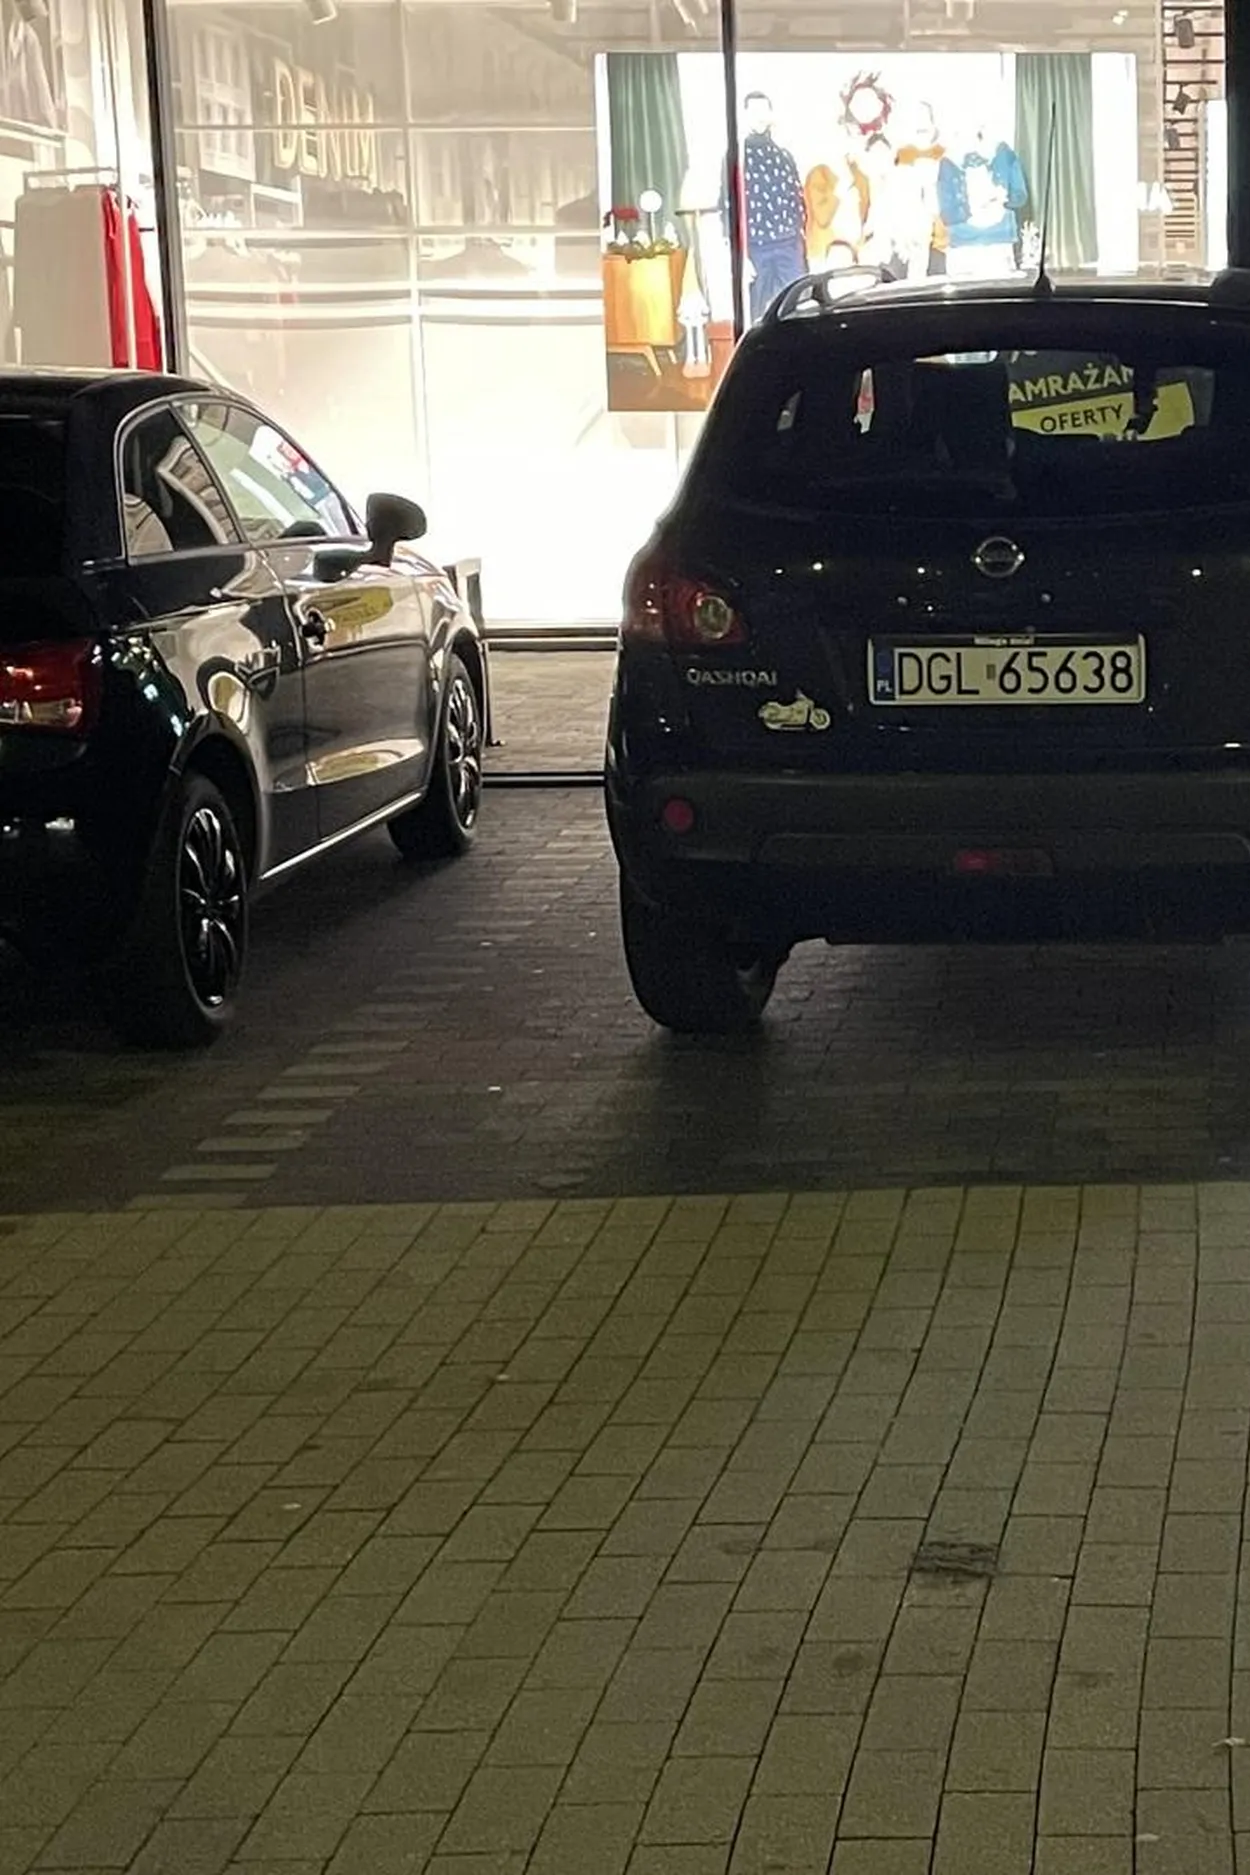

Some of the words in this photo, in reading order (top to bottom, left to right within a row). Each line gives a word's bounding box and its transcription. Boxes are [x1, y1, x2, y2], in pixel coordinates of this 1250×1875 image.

[1040, 403, 1123, 433] OFERTY
[686, 668, 779, 687] QASHQAI
[898, 651, 980, 695] DGL
[999, 650, 1133, 694] 65638
[876, 679, 893, 693] PL
